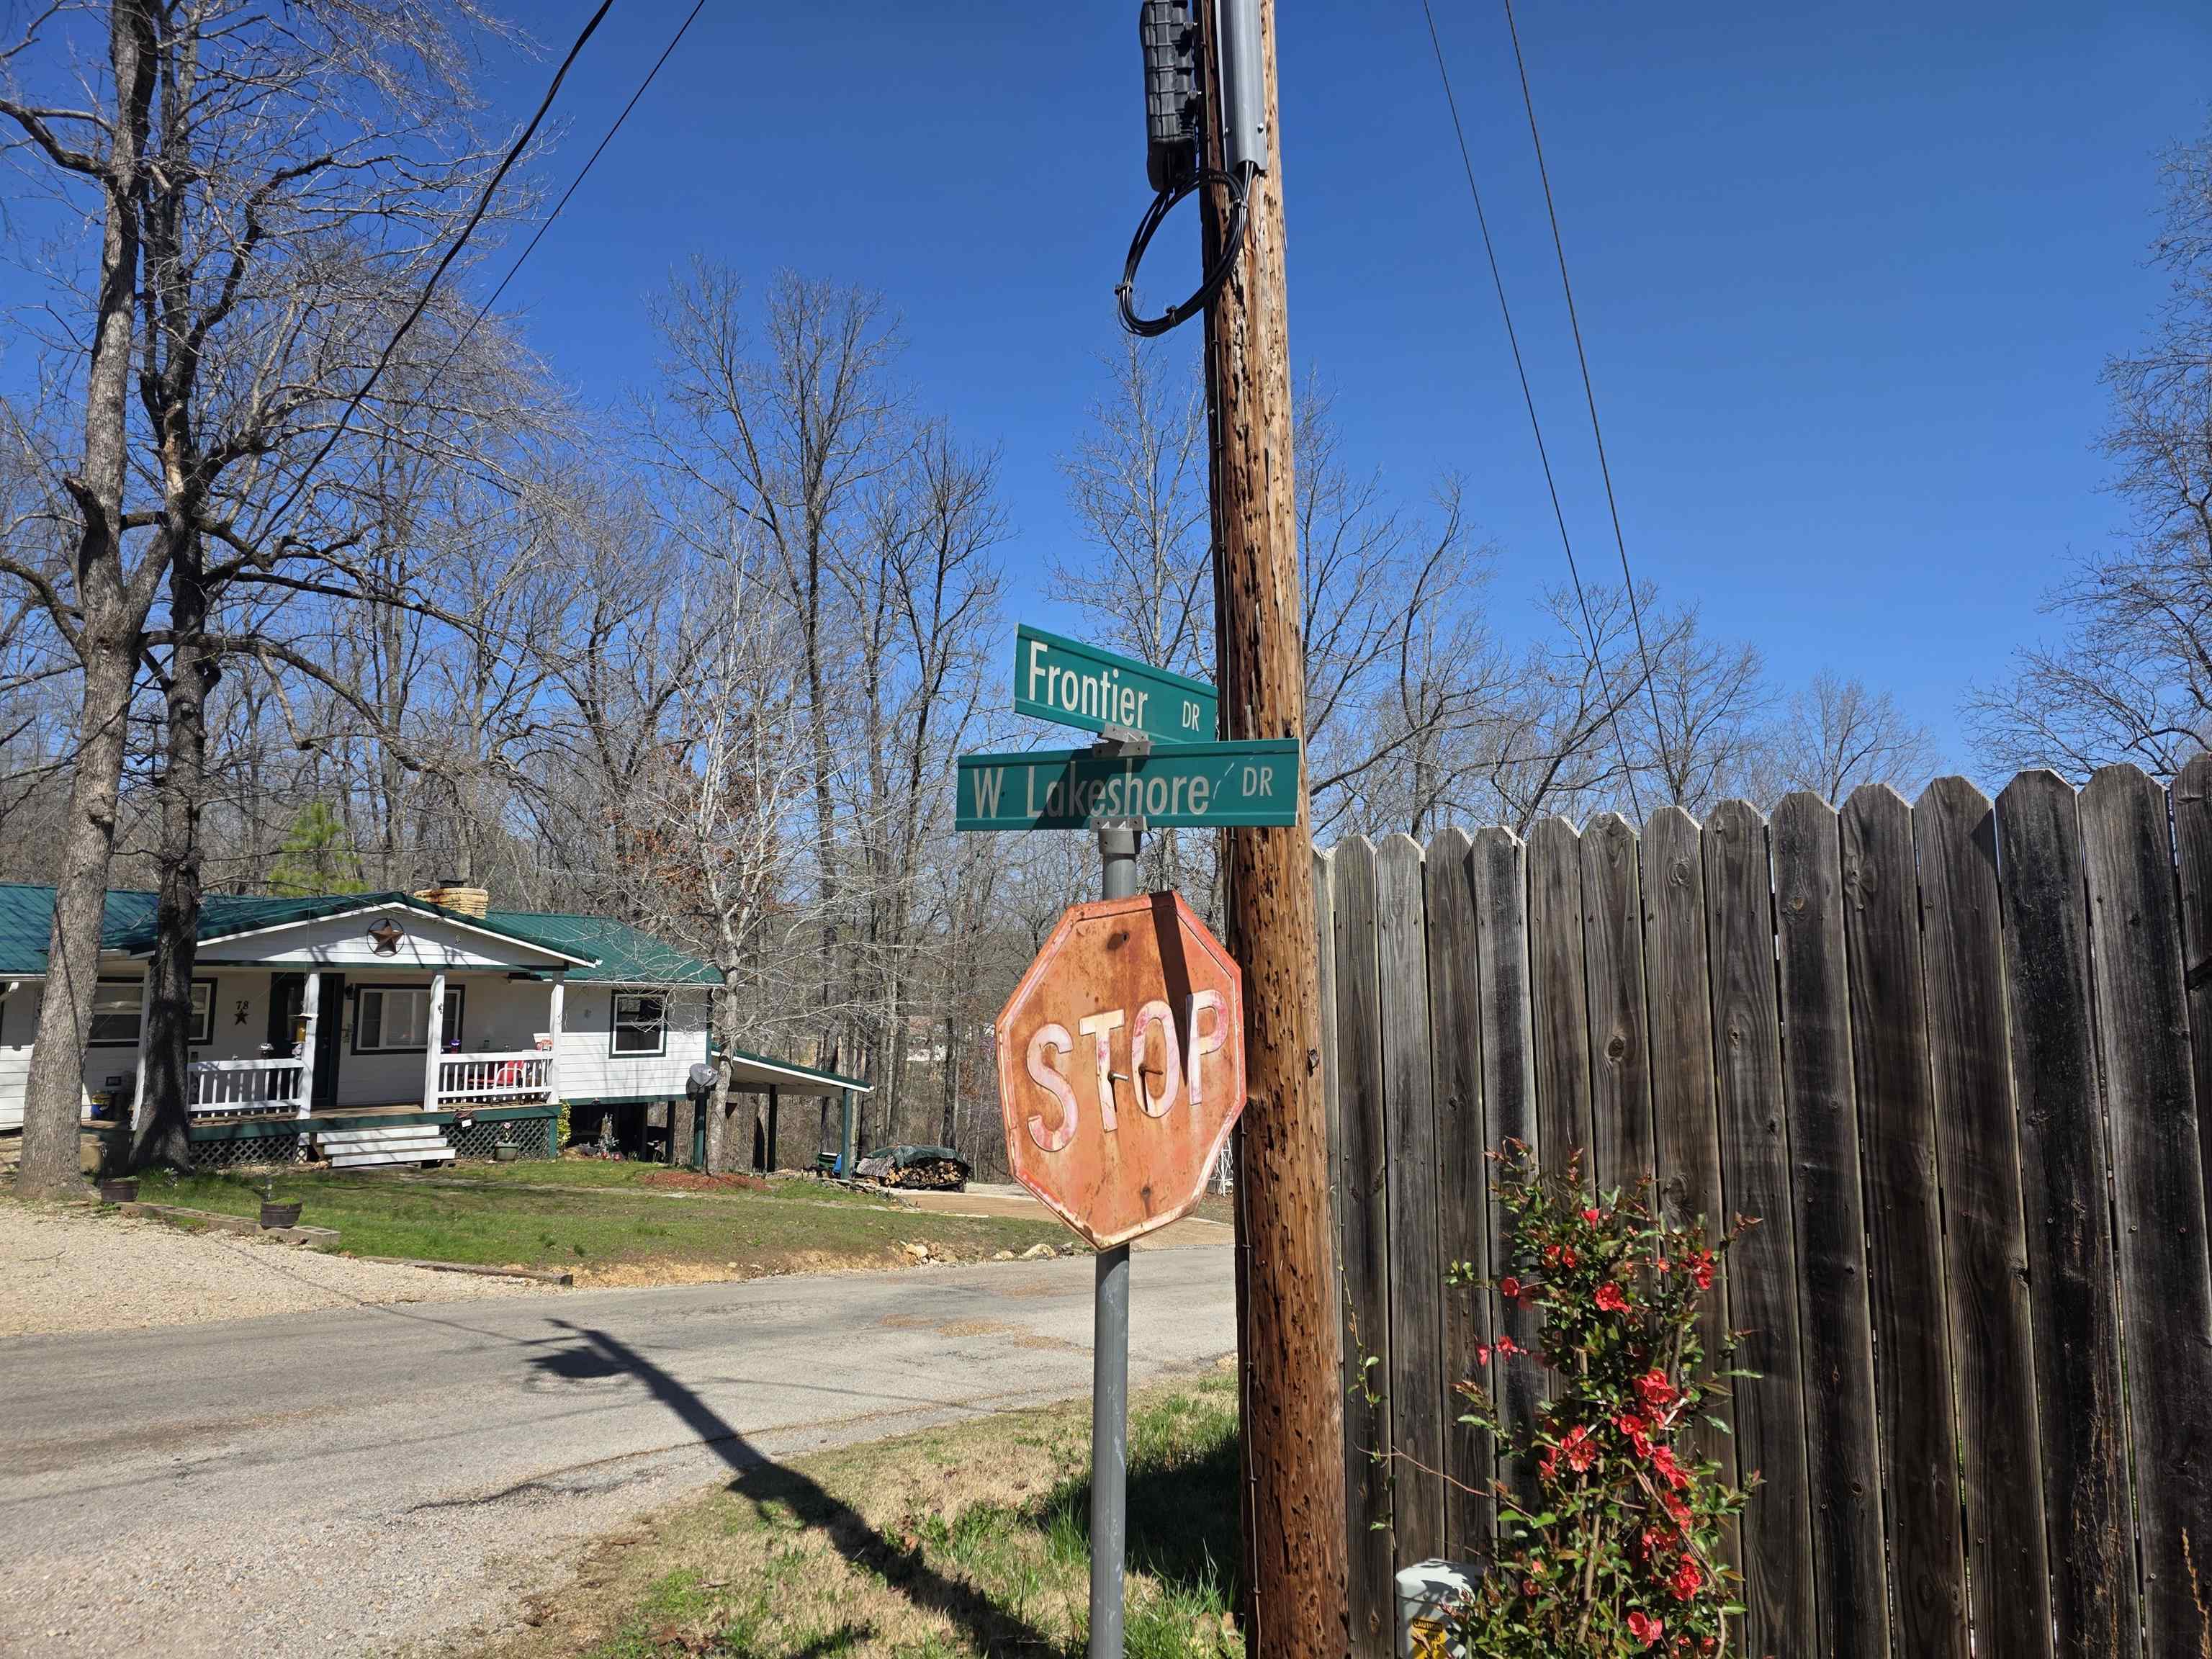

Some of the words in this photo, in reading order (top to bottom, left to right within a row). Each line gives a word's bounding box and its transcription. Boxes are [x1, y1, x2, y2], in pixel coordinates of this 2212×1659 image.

[1029, 641, 1148, 729] Frontier
[1182, 701, 1200, 732] DR
[973, 767, 1004, 819] W
[1027, 758, 1210, 818] Lakeshore
[1242, 767, 1273, 796] DR
[1027, 989, 1229, 1151] STOP
